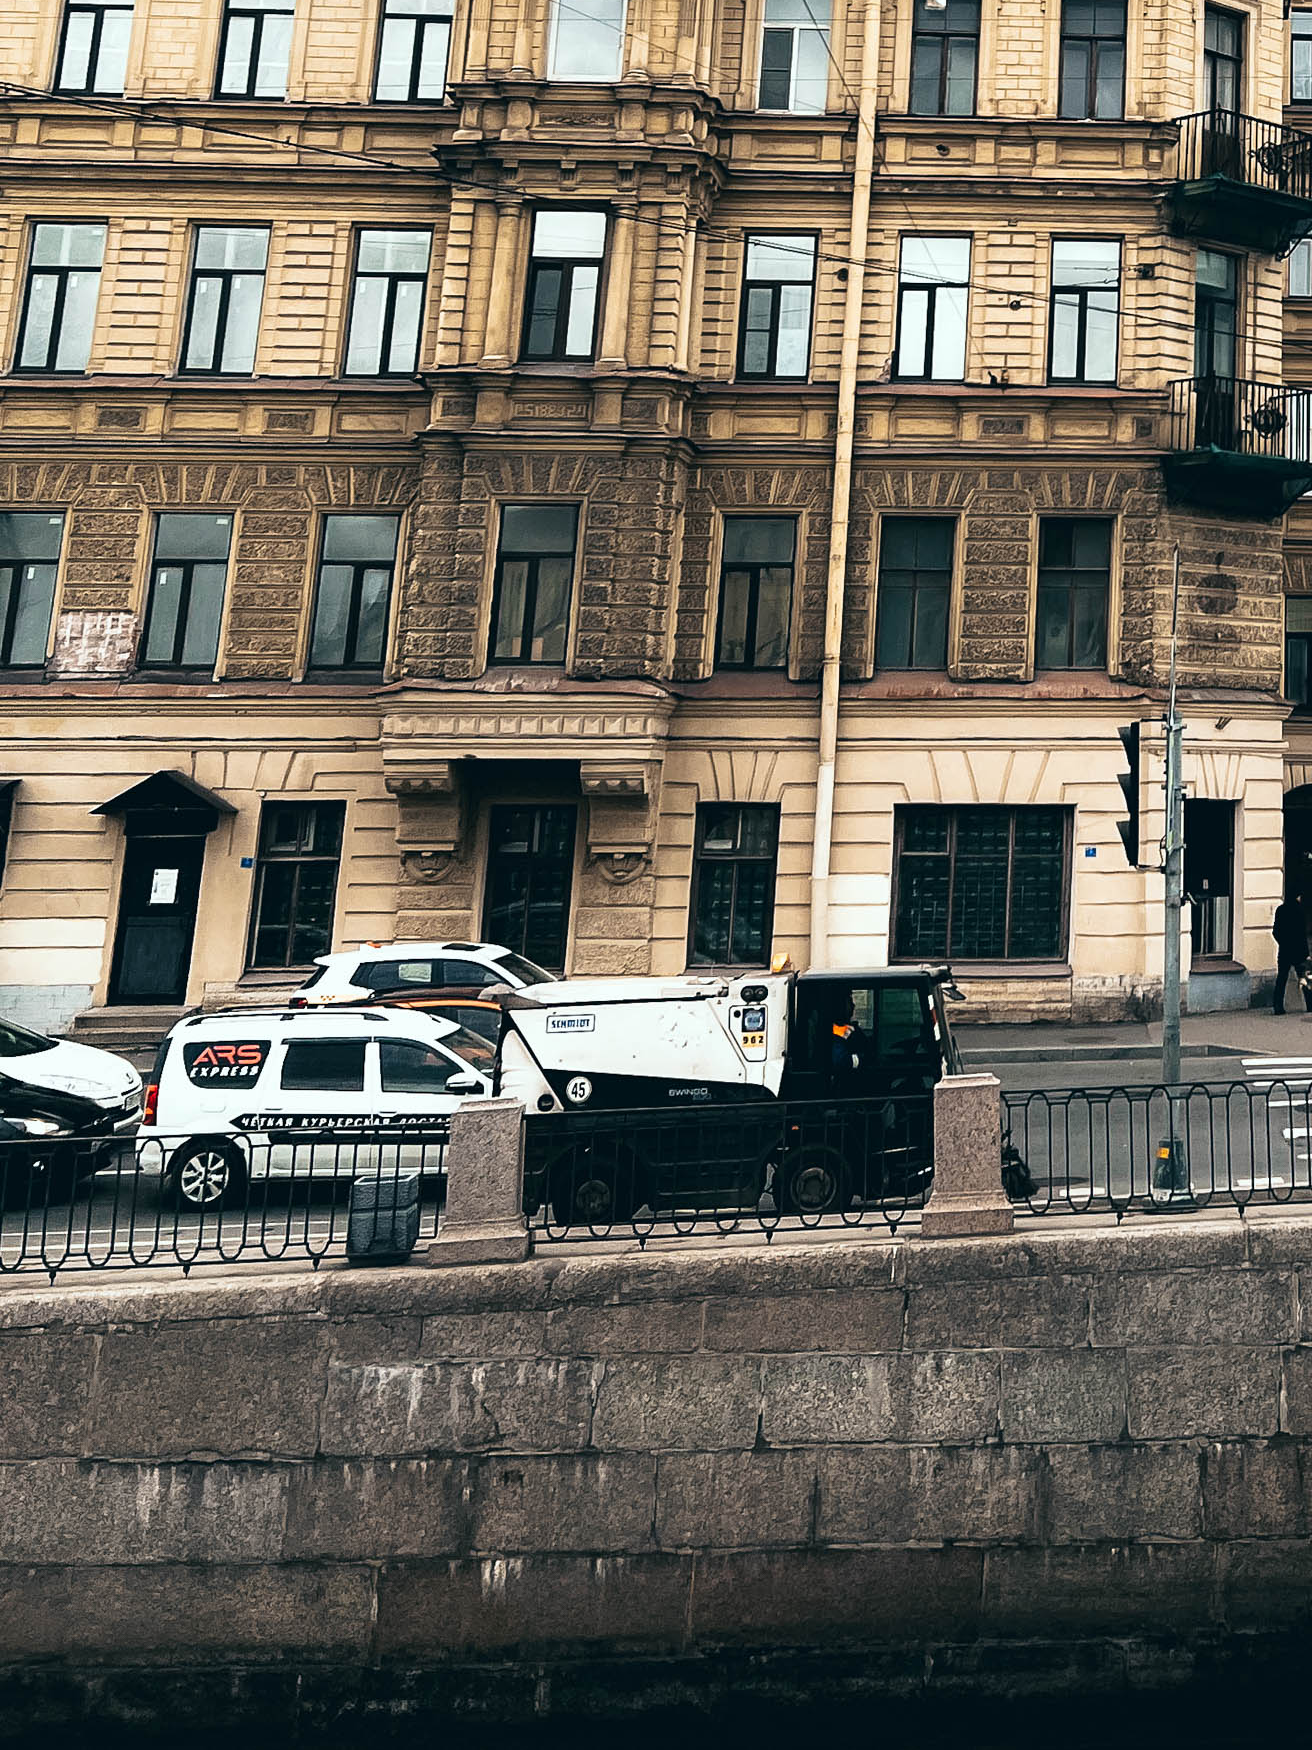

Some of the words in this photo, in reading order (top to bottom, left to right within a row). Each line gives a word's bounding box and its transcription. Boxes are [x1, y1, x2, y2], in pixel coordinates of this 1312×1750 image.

[551, 1018, 590, 1029] SCHMIDT
[192, 1044, 262, 1066] ARS
[190, 1065, 259, 1078] EXPRESS
[571, 1081, 586, 1099] 45
[301, 1117, 390, 1128] КУРЬЕРСКАЯ
